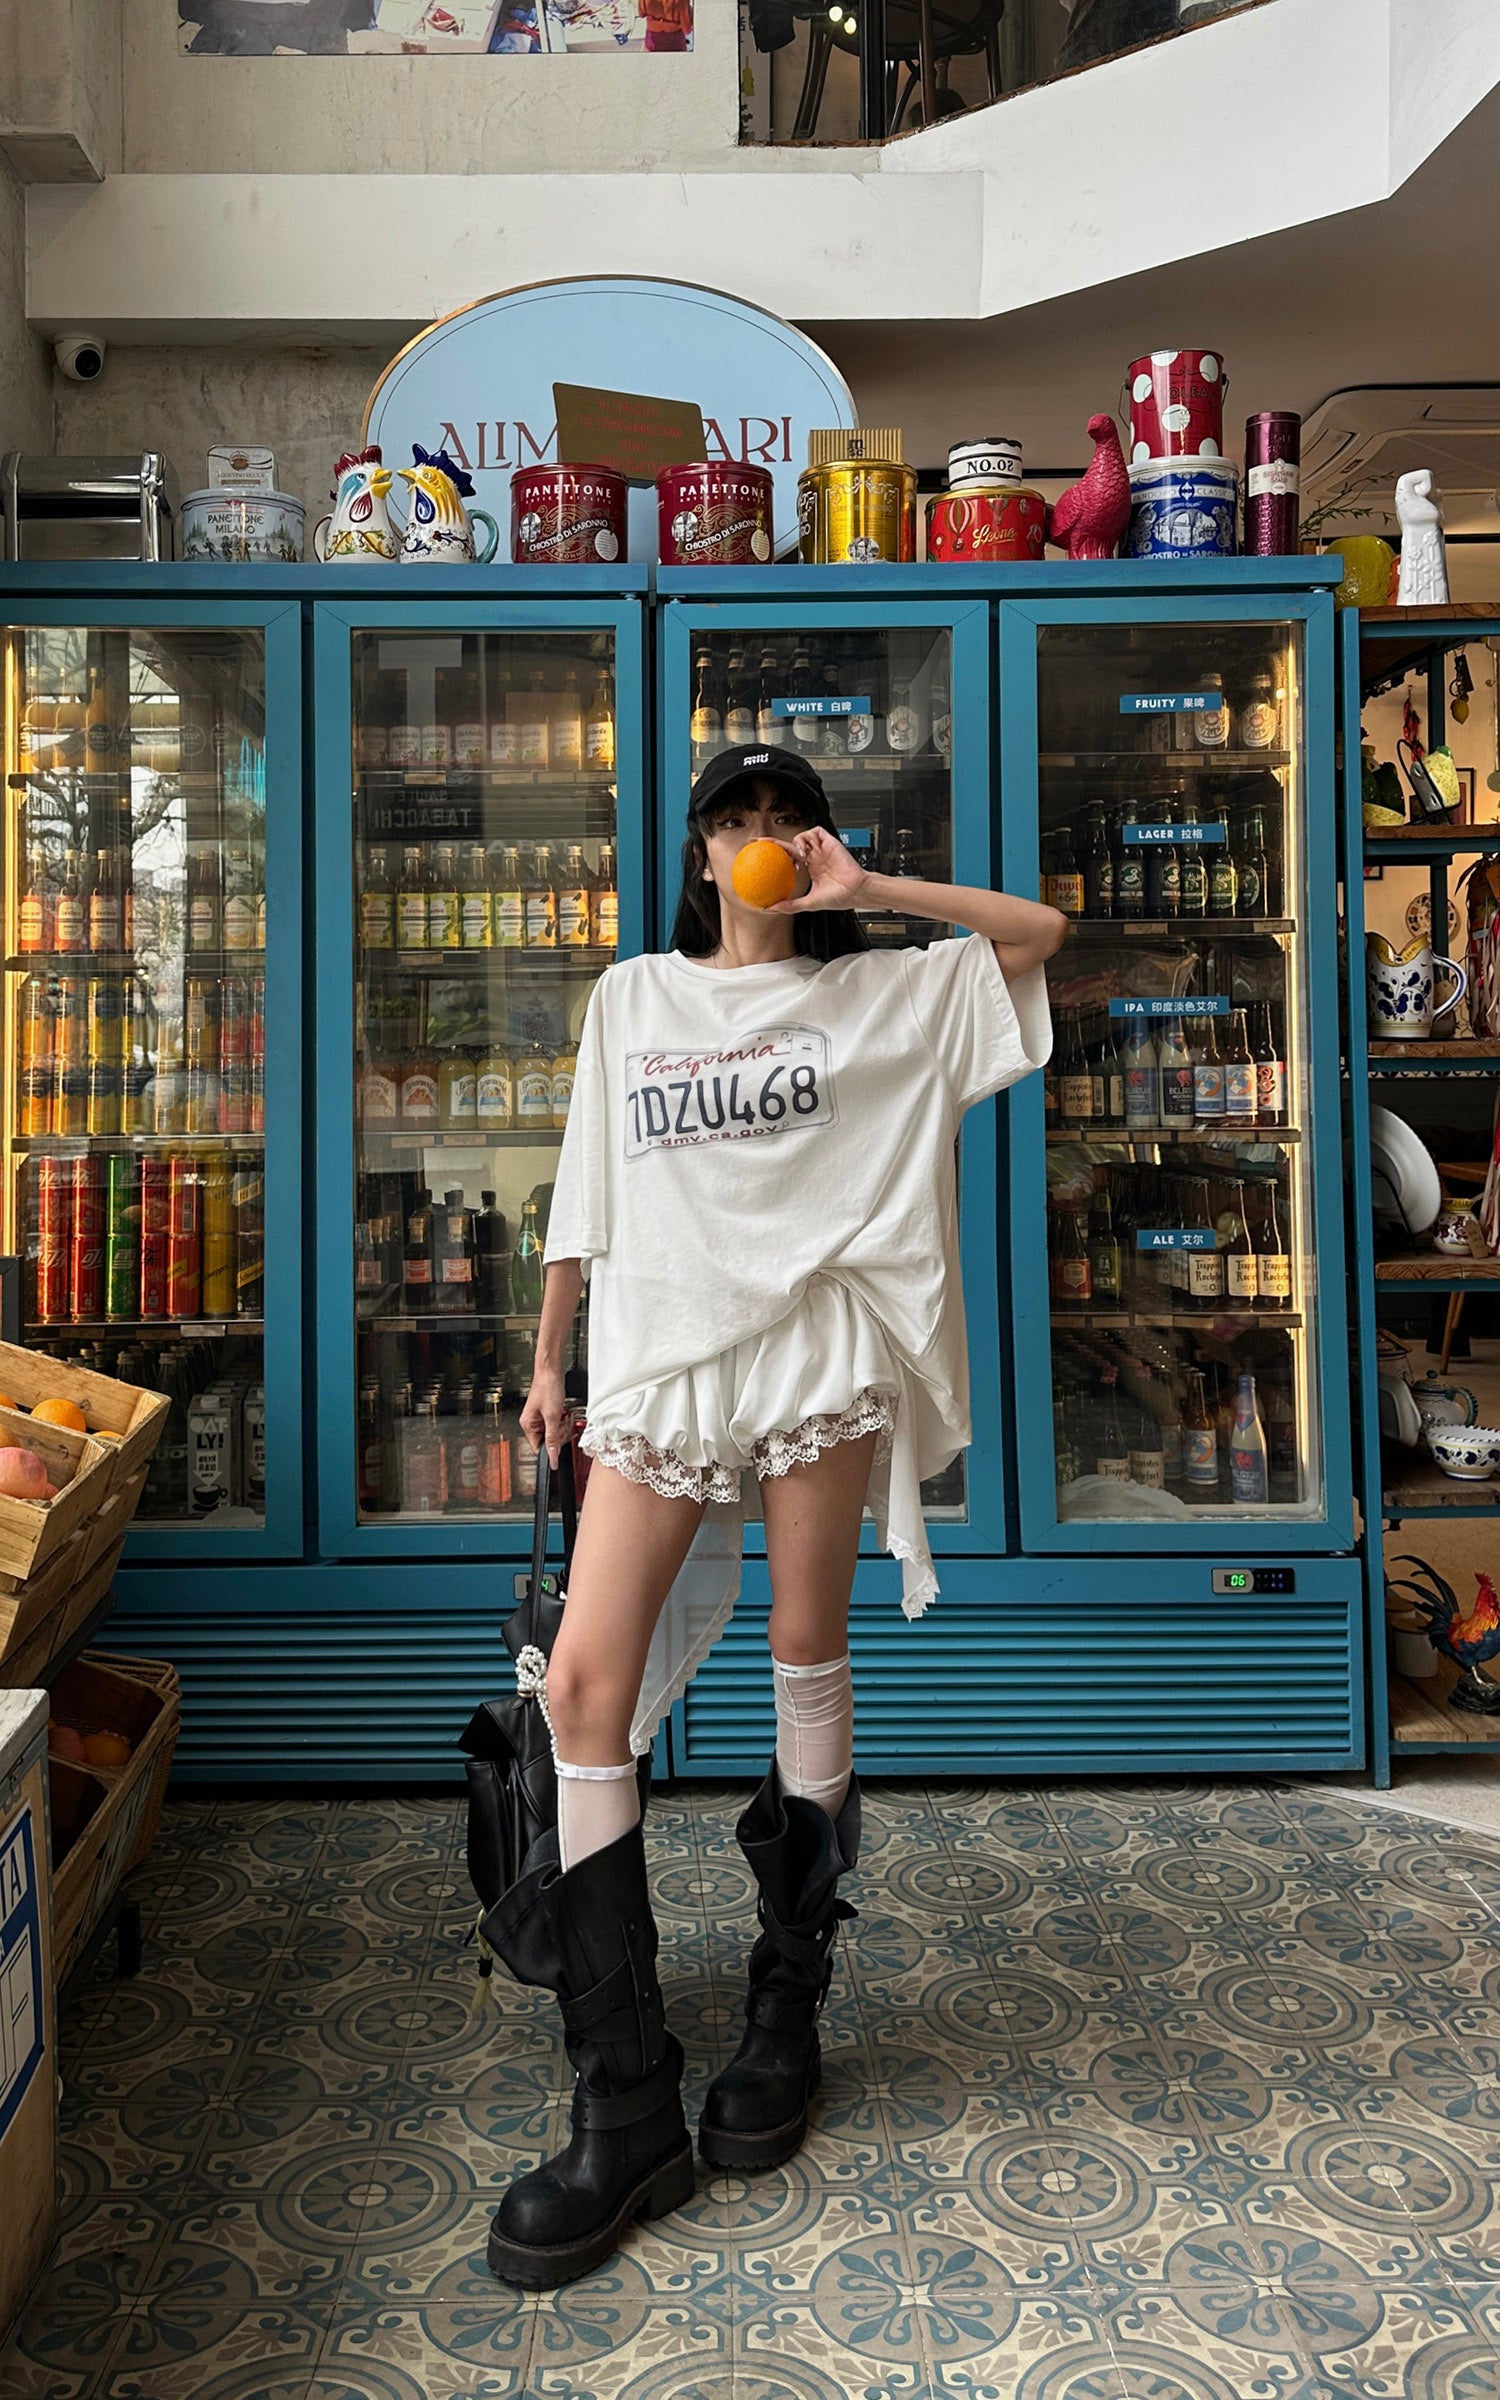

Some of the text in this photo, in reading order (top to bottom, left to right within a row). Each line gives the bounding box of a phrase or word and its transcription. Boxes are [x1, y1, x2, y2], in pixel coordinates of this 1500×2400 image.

[525, 484, 612, 499] PANETTONE
[679, 484, 765, 499] PANETTONE
[207, 513, 265, 525] PANETTONE
[215, 524, 256, 534] MILANO
[529, 519, 608, 552] CHIOSTRO DI SARONNO
[685, 519, 762, 552] CHIOSTRO DI SARONNO
[972, 524, 1016, 549] Leone
[786, 701, 852, 713] WHITE 白啤
[1135, 697, 1205, 709] FRUITY 果啤
[1138, 828, 1203, 839] LAGER 拉格
[1124, 1001, 1218, 1013] IPA 印度淡色艾尔
[628, 1065, 819, 1142] 1DZU468
[661, 1125, 778, 1146] dmv.ca.gov
[1153, 1234, 1204, 1246] ALE 艾尔
[197, 1433, 224, 1449] LY!
[1230, 1574, 1246, 1586] 06
